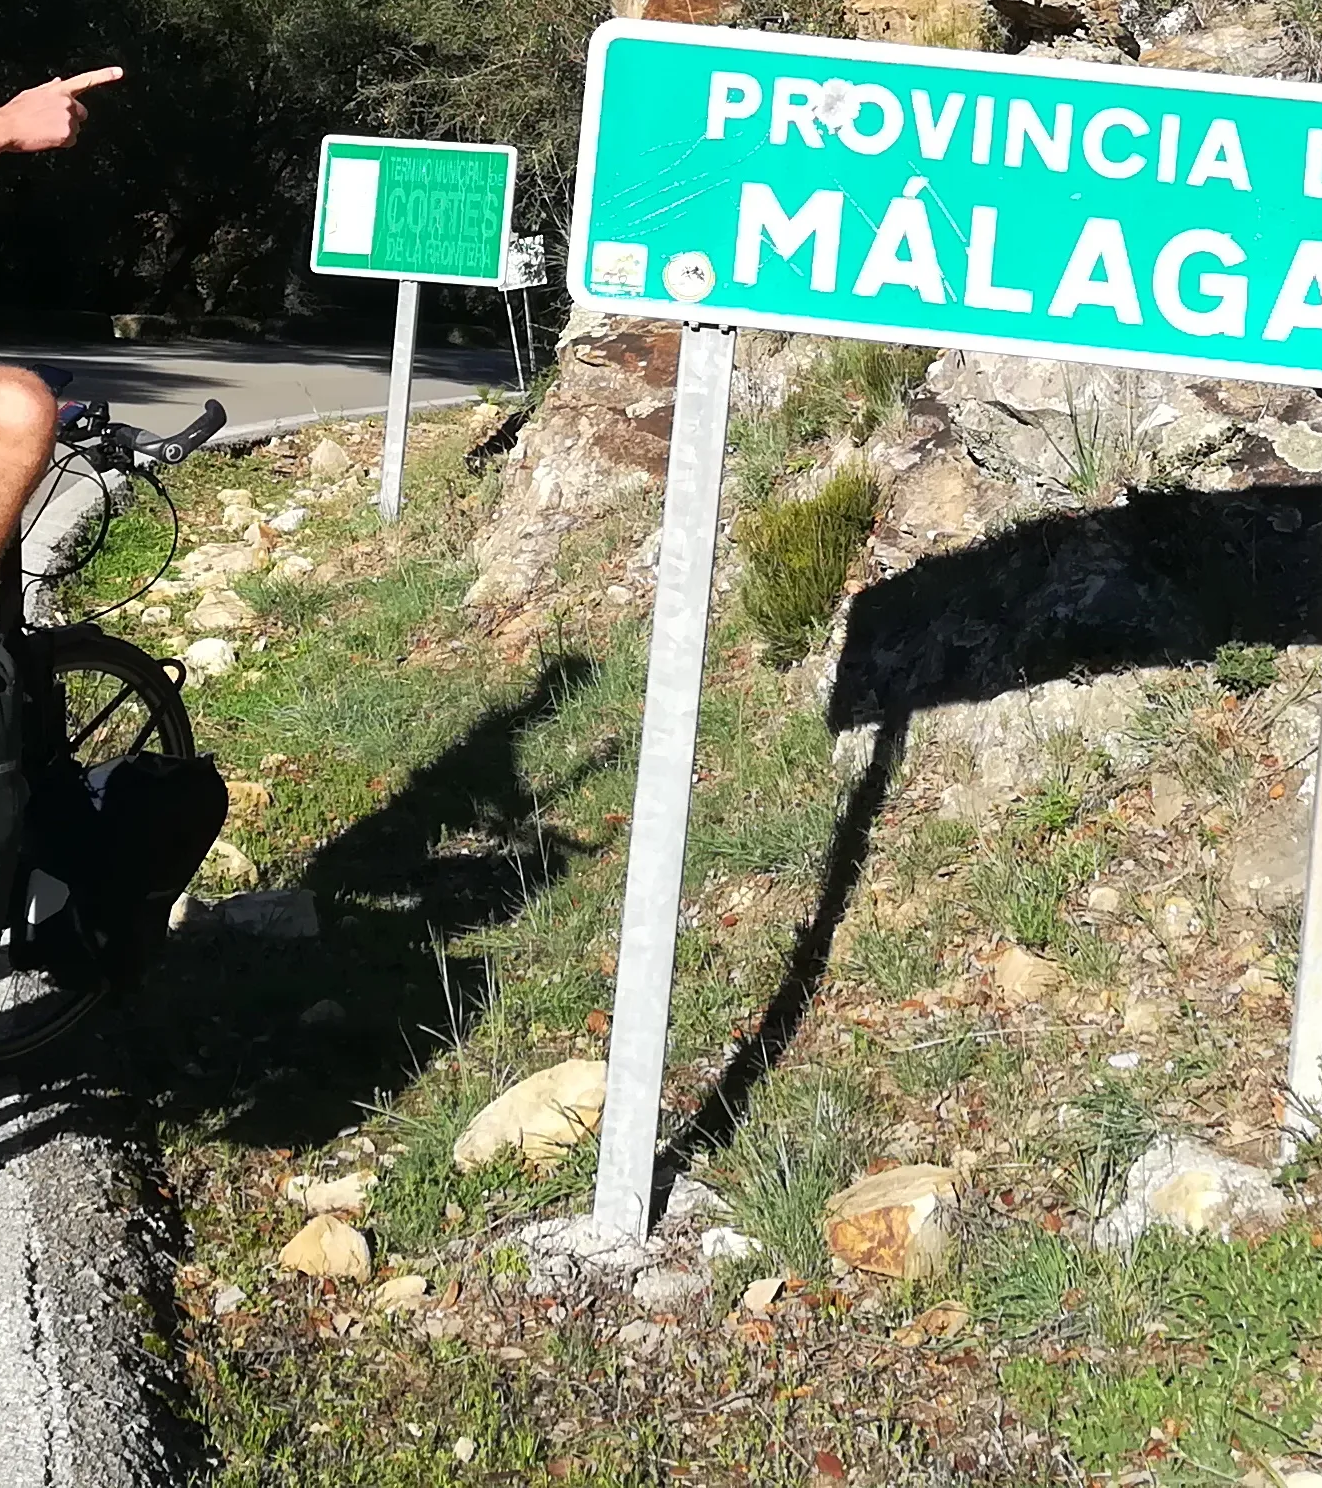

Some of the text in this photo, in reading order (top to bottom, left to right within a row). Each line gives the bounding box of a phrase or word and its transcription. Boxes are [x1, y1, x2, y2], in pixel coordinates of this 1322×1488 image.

[705, 70, 1253, 191] PROVINCIA
[489, 173, 505, 186] DE
[387, 188, 498, 237] CORTES
